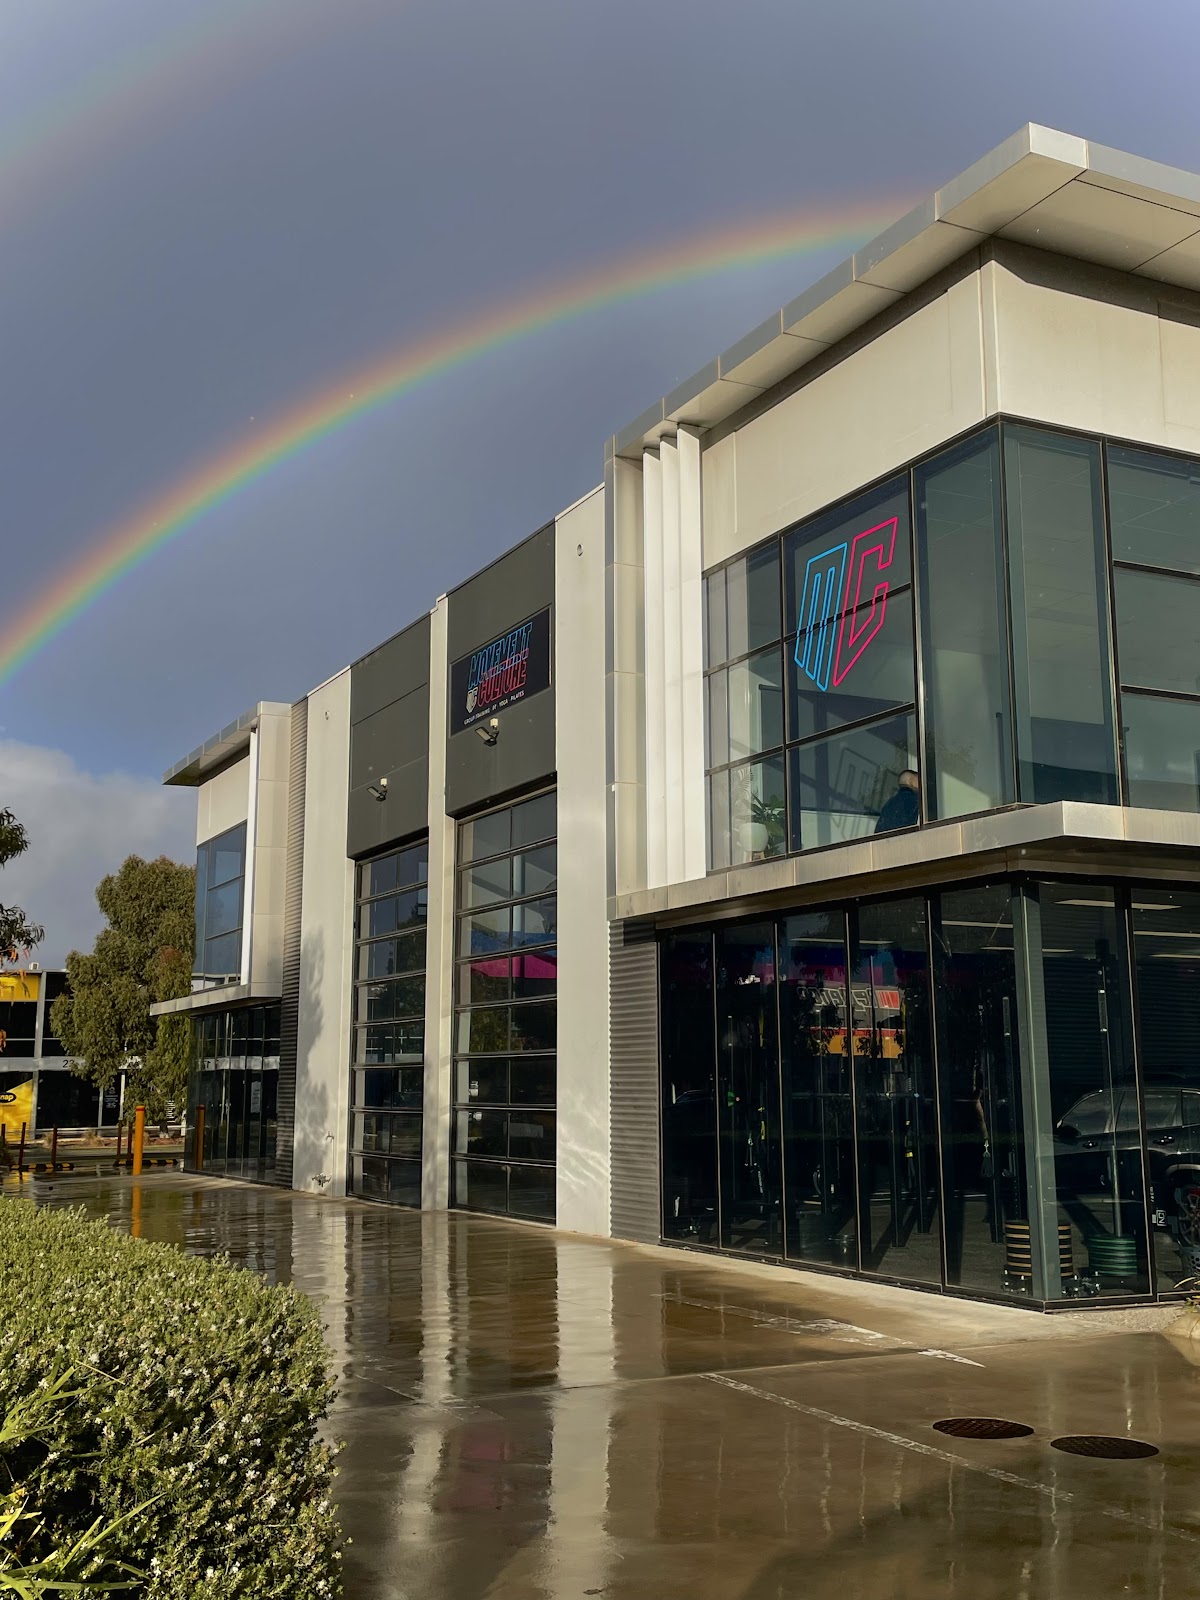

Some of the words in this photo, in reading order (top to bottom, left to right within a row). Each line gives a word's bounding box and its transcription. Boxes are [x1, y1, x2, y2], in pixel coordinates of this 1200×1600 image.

[468, 622, 532, 690] MOVEMENT
[477, 647, 529, 707] CULTURE
[0, 1094, 14, 1102] nap
